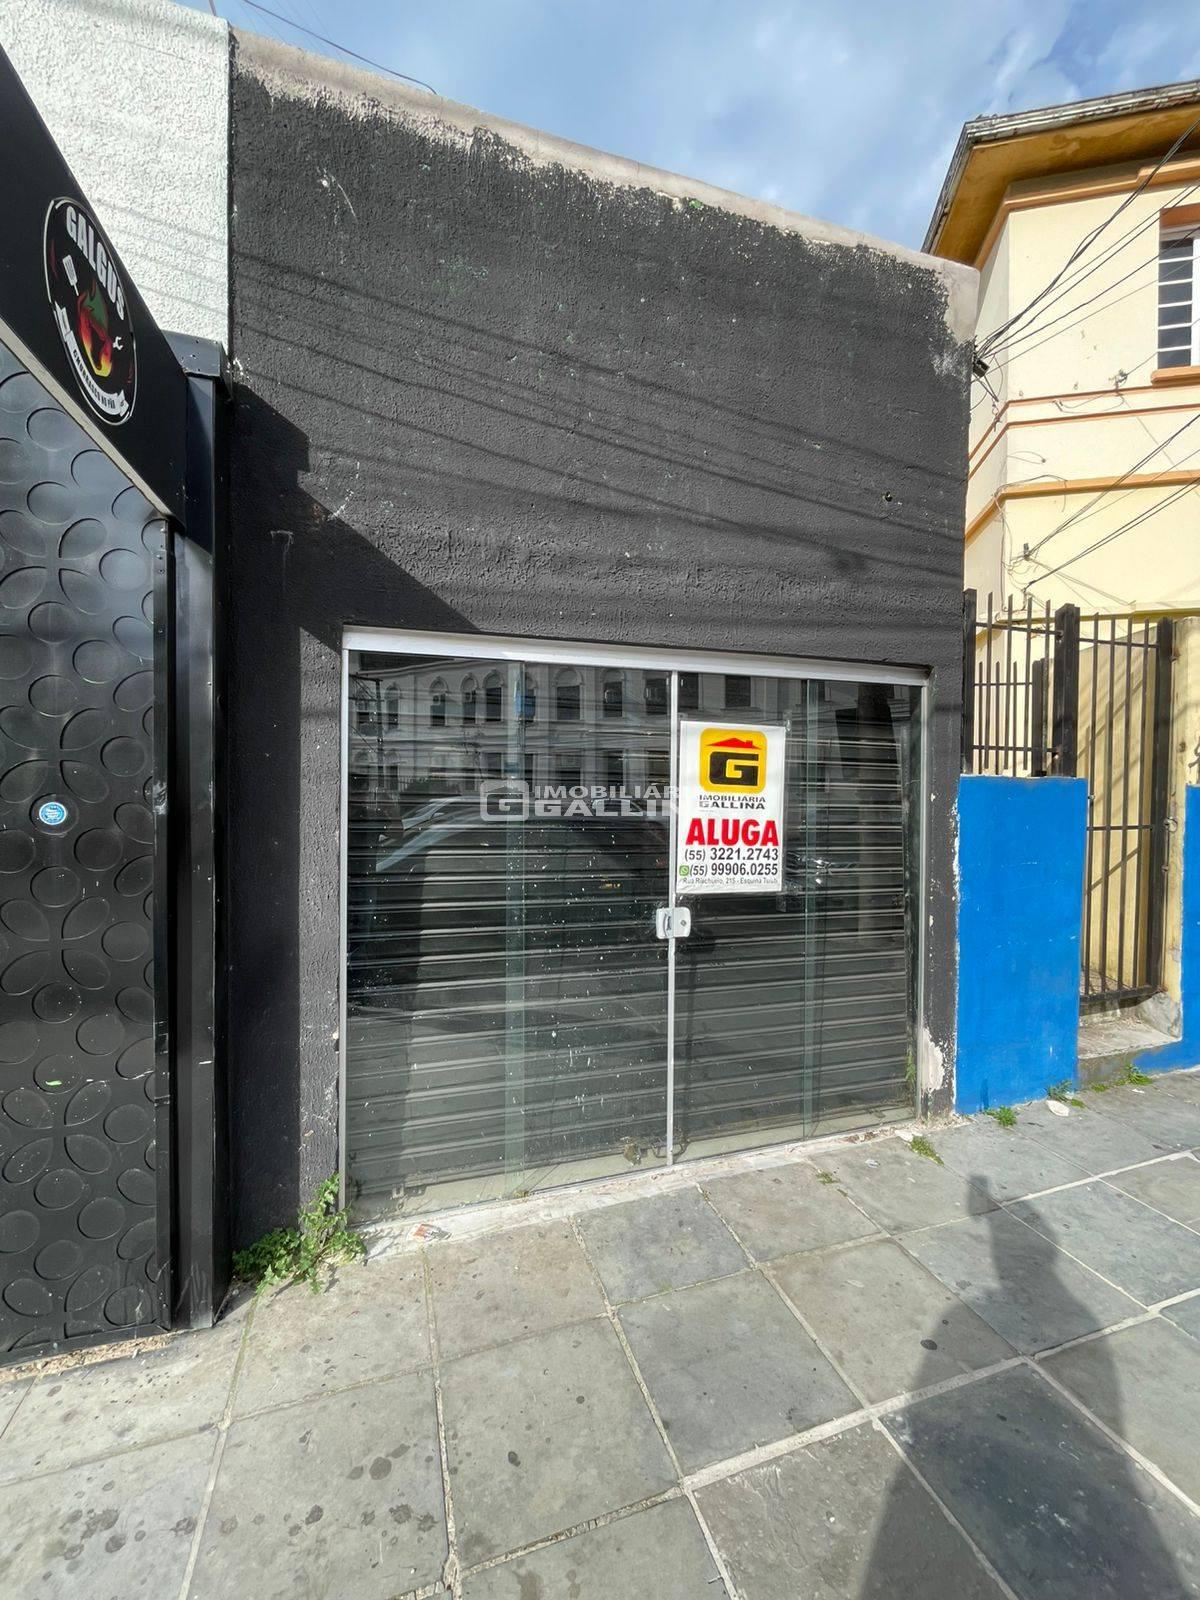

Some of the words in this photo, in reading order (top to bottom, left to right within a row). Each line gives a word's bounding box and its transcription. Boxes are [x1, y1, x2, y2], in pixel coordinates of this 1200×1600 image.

[64, 205, 125, 321] GALGUS
[699, 801, 766, 810] GALLINA
[685, 818, 779, 846] ALUGA
[684, 848, 706, 862] (55)
[710, 847, 779, 861] 3221.2743
[689, 864, 708, 877] (55)
[711, 863, 778, 876] 99906.0255
